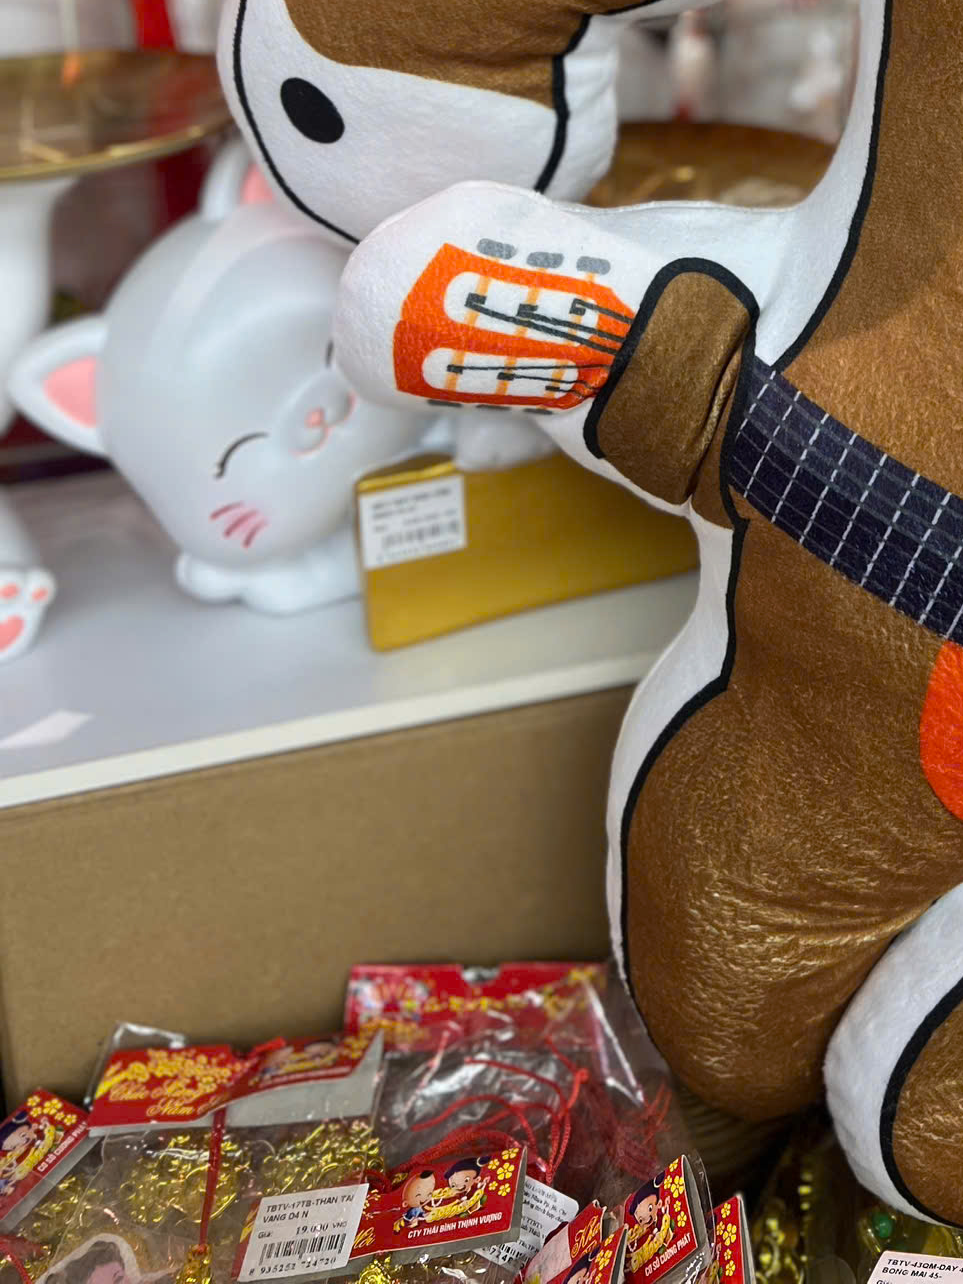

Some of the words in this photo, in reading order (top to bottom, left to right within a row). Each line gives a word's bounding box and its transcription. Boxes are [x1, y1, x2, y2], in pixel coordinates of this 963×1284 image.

[266, 1196, 338, 1213] TBTV-17TB-THAN
[341, 1194, 355, 1203] TAI
[262, 1213, 287, 1223] VANG
[301, 1210, 310, 1219] N
[407, 1229, 422, 1239] CTY
[423, 1226, 439, 1236] THÁI
[882, 1266, 909, 1276] BONG
[910, 1270, 927, 1278] MAI
